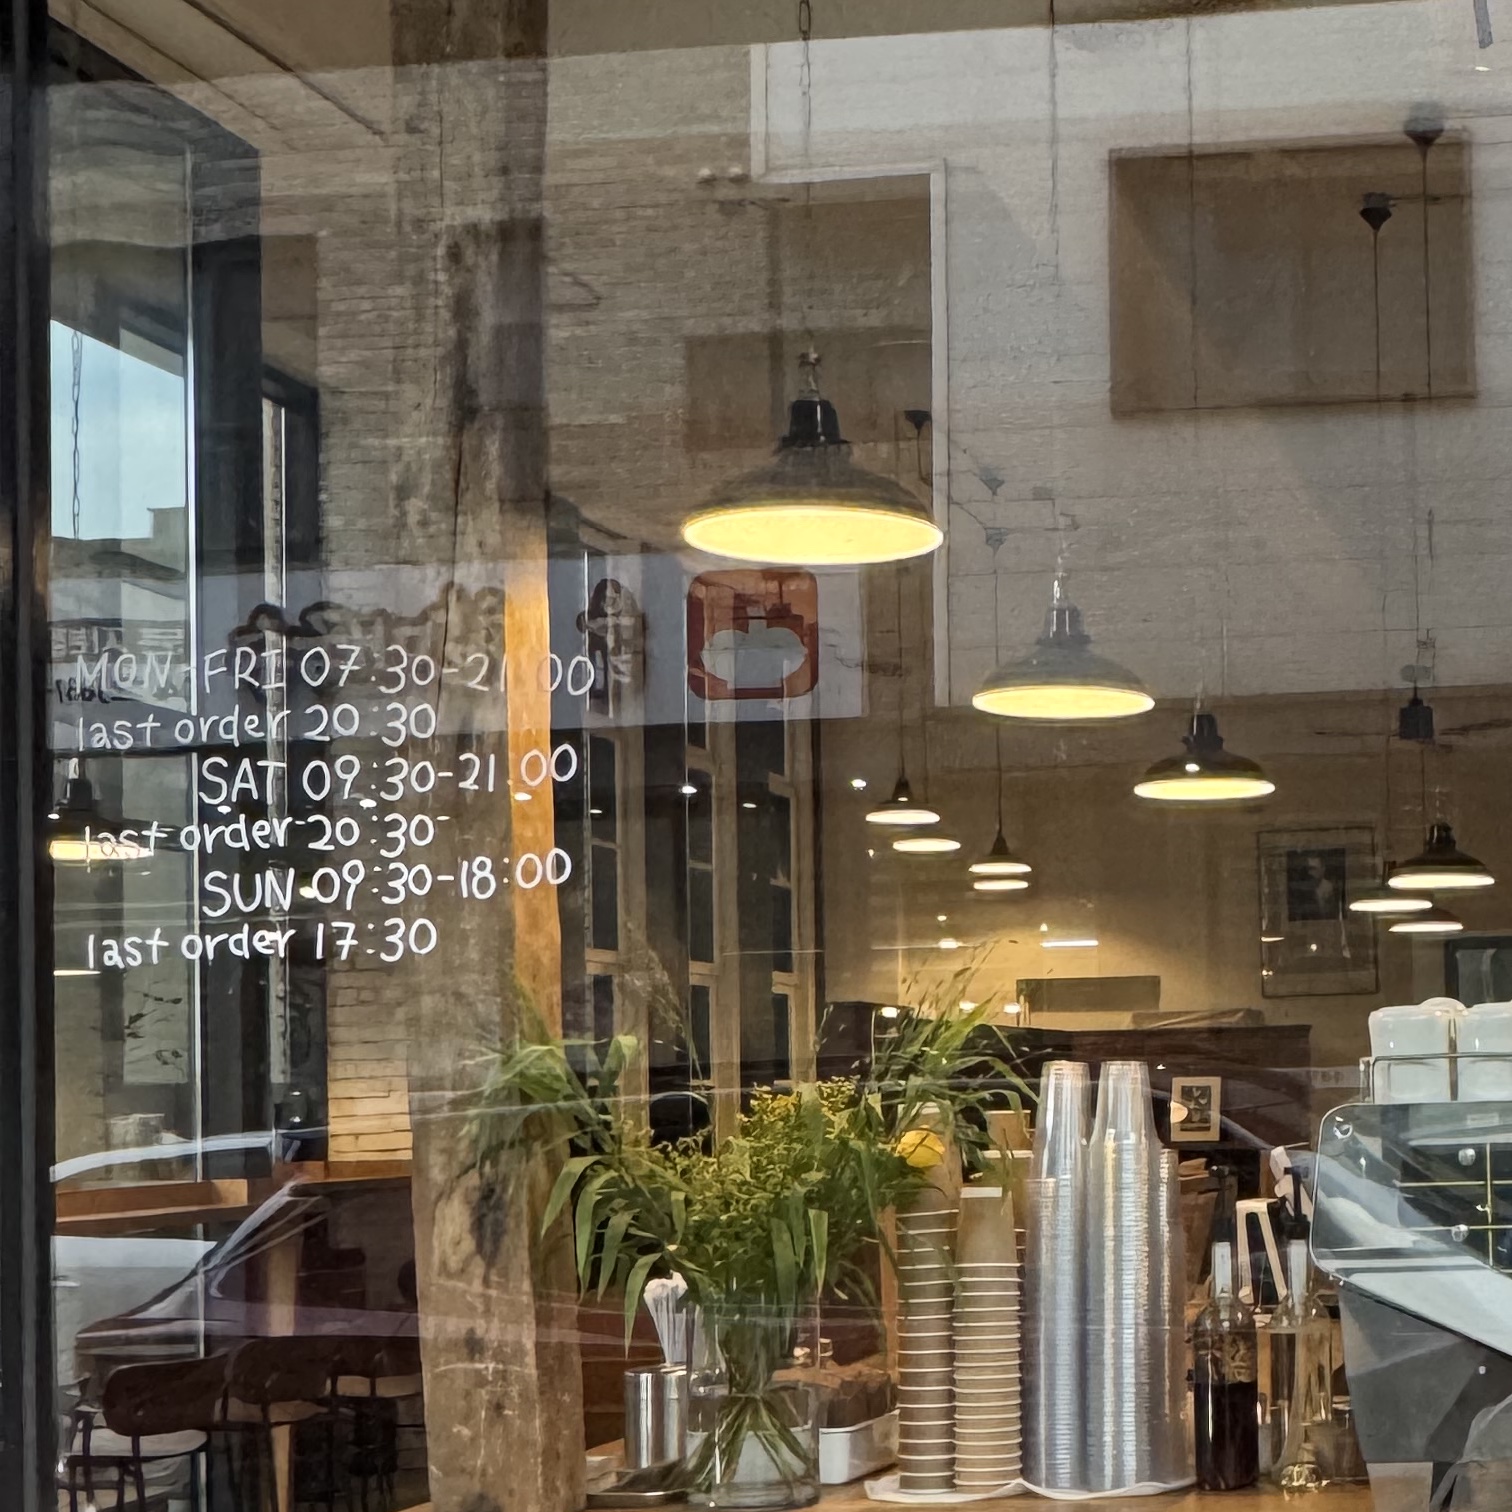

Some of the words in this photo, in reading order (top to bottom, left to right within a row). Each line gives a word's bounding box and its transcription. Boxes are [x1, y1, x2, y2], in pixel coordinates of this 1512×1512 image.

[78, 713, 162, 752] last
[174, 704, 291, 747] order
[304, 702, 436, 747] 20:30
[199, 756, 287, 804] SAT
[84, 821, 168, 873] last
[180, 814, 293, 854] order
[307, 813, 435, 858] 20:30
[202, 867, 295, 917] SUN
[312, 848, 572, 910] 09:30-18:00
[88, 927, 169, 969] last
[181, 923, 297, 962] order
[316, 918, 437, 962] 17:30
